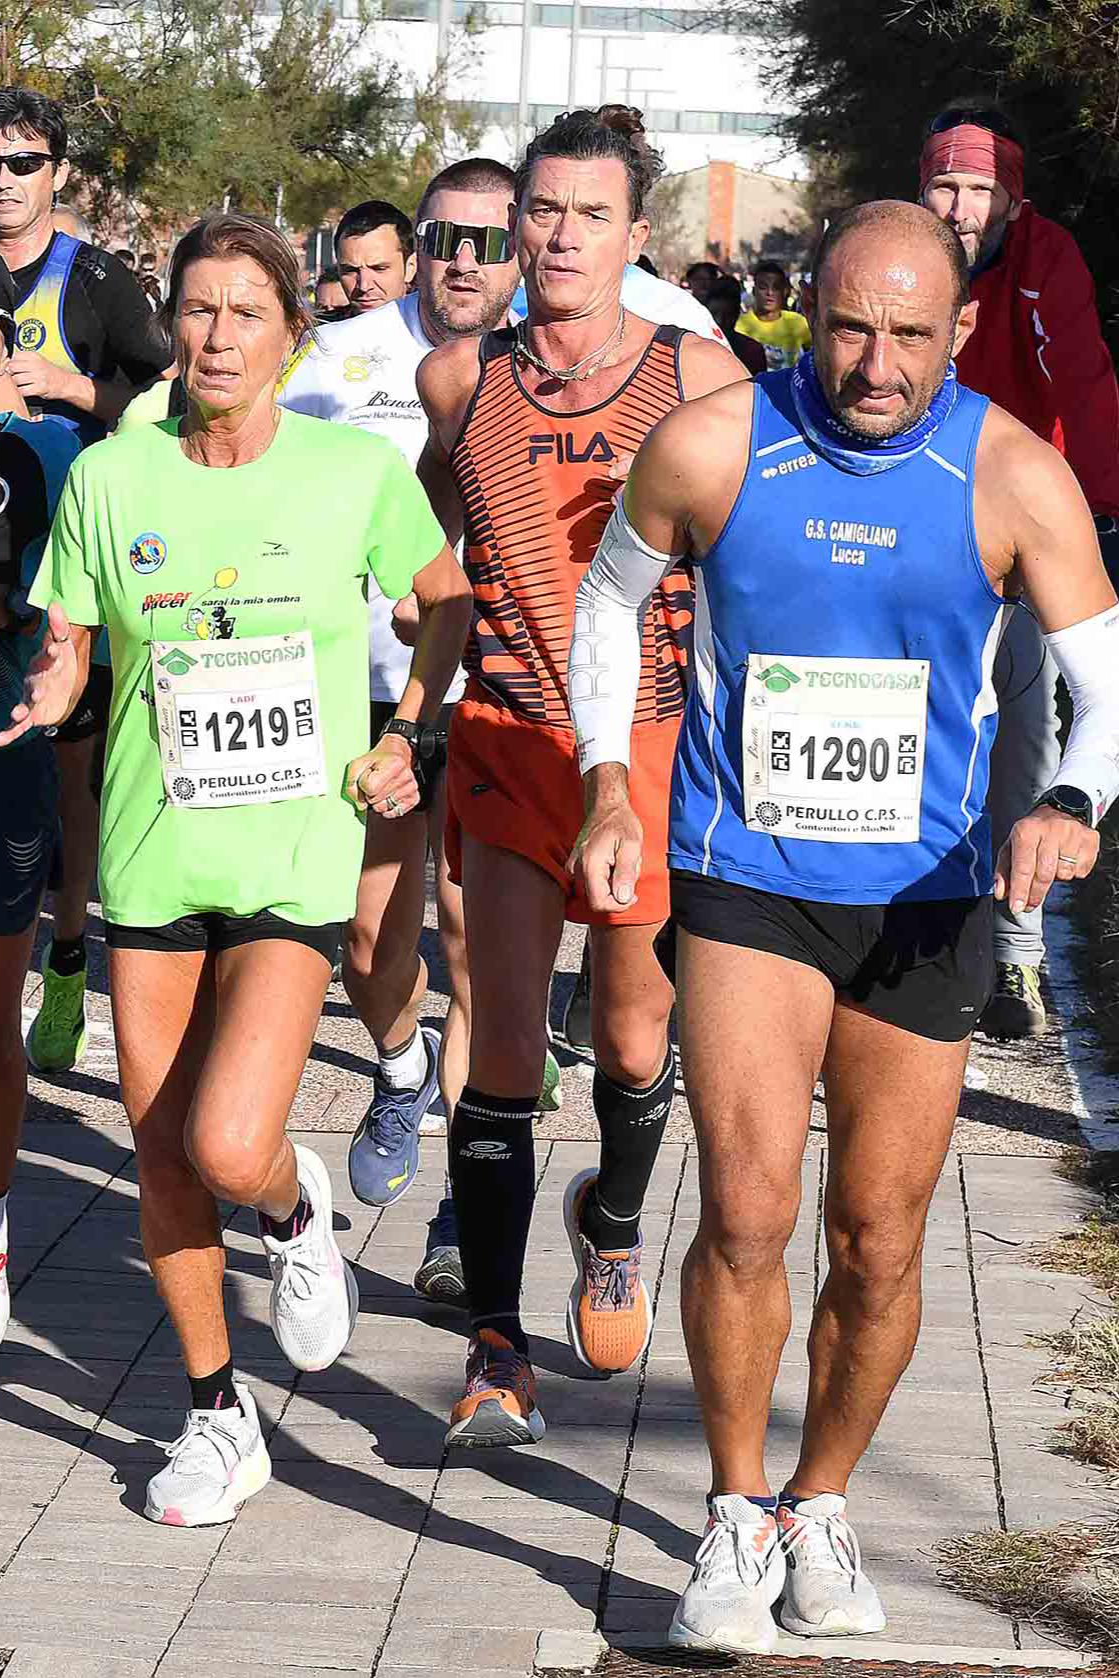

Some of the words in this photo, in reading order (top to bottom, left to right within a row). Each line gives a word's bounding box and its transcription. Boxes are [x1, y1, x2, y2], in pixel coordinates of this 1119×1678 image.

[529, 432, 614, 465] FILA
[778, 453, 817, 475] errea
[804, 518, 826, 539] G.S.
[829, 521, 897, 549] CAMIGLIANO
[831, 544, 865, 566] Lucca
[266, 595, 301, 604] ombra
[201, 644, 307, 668] TECNOCASA
[804, 671, 922, 690] TECNOCASA
[206, 707, 289, 752] 1219
[800, 735, 890, 782] 1290
[199, 773, 267, 789] PERULLO
[271, 767, 306, 782] C.P.S.
[785, 805, 859, 821] PERULLO
[864, 808, 901, 821] C.P.S.
[795, 822, 851, 832] Contenitori
[473, 1152, 513, 1160] SPORT
